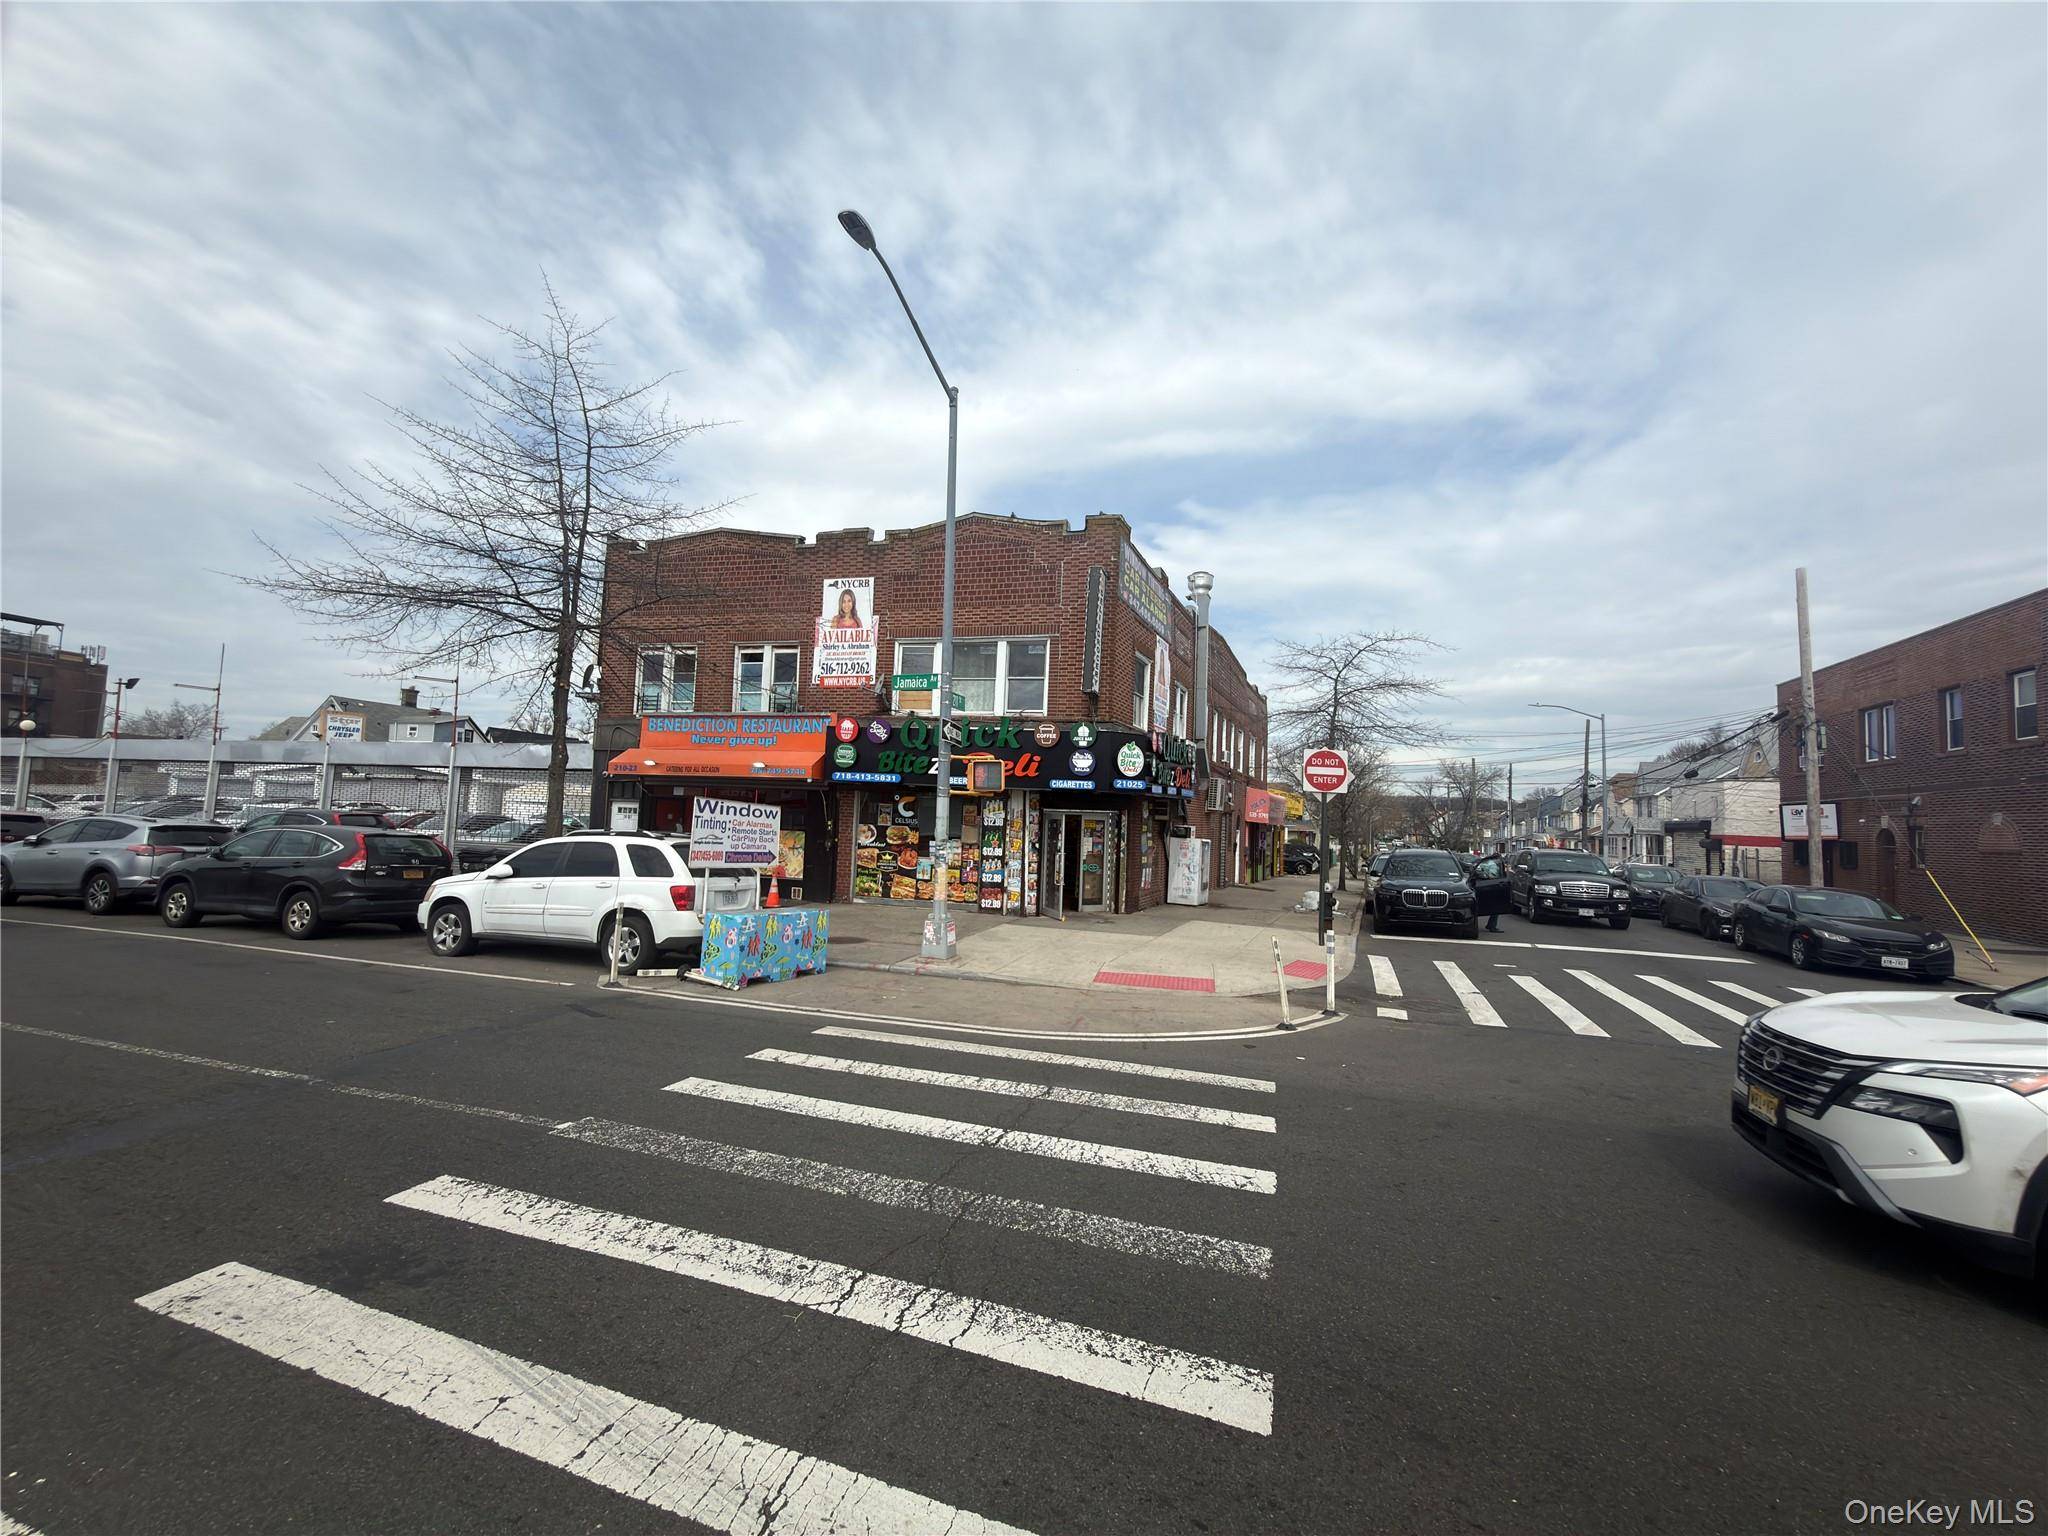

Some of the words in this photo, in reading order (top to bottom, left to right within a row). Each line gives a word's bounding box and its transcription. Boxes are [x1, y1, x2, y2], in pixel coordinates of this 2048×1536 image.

[840, 580, 870, 588] NYCRB
[1124, 574, 1140, 599] CAR
[822, 629, 871, 643] AVAILABLE
[821, 662, 870, 674] 516-712-9262
[894, 675, 928, 688] Jamaica
[328, 725, 361, 733] CHRYSLER
[648, 717, 737, 733] BENEDICTION
[742, 717, 832, 733] RESTAURANT
[900, 717, 1024, 750] Qick
[691, 735, 726, 745] Never
[730, 736, 755, 747] give
[758, 735, 777, 747] up!
[1121, 751, 1141, 759] Quick
[1324, 758, 1339, 766] NOT
[834, 773, 897, 782] 718-413-5831
[949, 777, 967, 785] BEER
[1313, 776, 1337, 784] ENTER
[1051, 780, 1093, 788] CIGARETTES
[1116, 780, 1143, 788] 21025
[696, 798, 778, 820] Window
[695, 816, 727, 833] Tinting
[746, 820, 773, 828] Alarmas
[732, 827, 757, 835] Remote
[758, 828, 777, 836] Starts
[731, 835, 757, 843] CarPlay
[727, 853, 752, 861] Chrome
